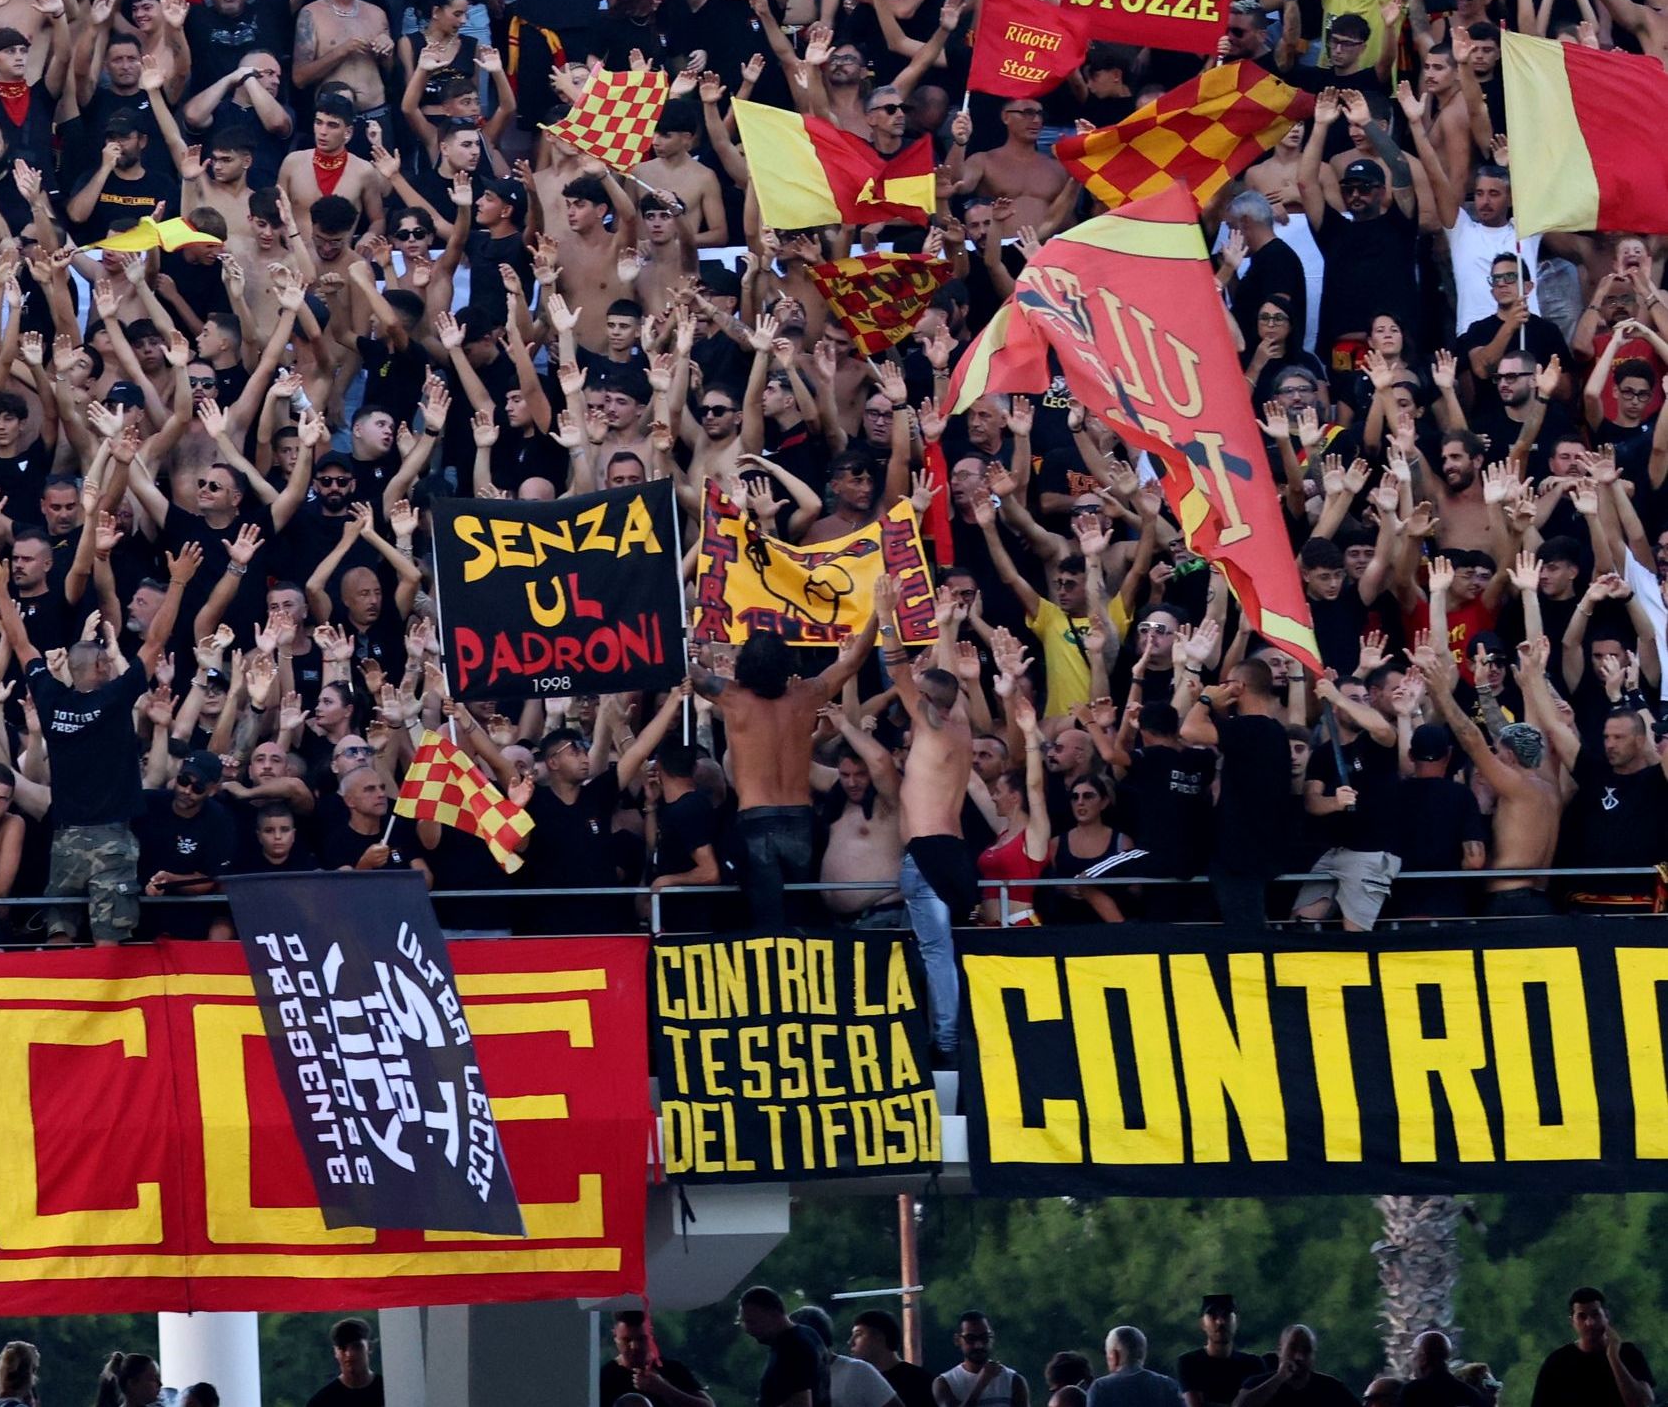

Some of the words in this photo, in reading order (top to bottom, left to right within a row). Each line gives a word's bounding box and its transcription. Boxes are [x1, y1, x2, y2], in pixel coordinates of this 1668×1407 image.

[1003, 59, 1049, 81] Stozz
[1006, 27, 1062, 52] Ridotti
[1024, 50, 1036, 62] a
[454, 496, 662, 582] SENZA
[526, 572, 603, 627] UL
[455, 613, 663, 688] PADRONI
[532, 676, 572, 692] 1998
[654, 938, 837, 1021] CONTRO
[853, 940, 917, 1015] LA
[255, 932, 354, 1185] PRESENTE
[283, 933, 376, 1185] DOTTORE
[663, 1023, 921, 1099] TESSERA
[962, 946, 1603, 1165] CONTRO
[463, 1064, 495, 1203] LECCE
